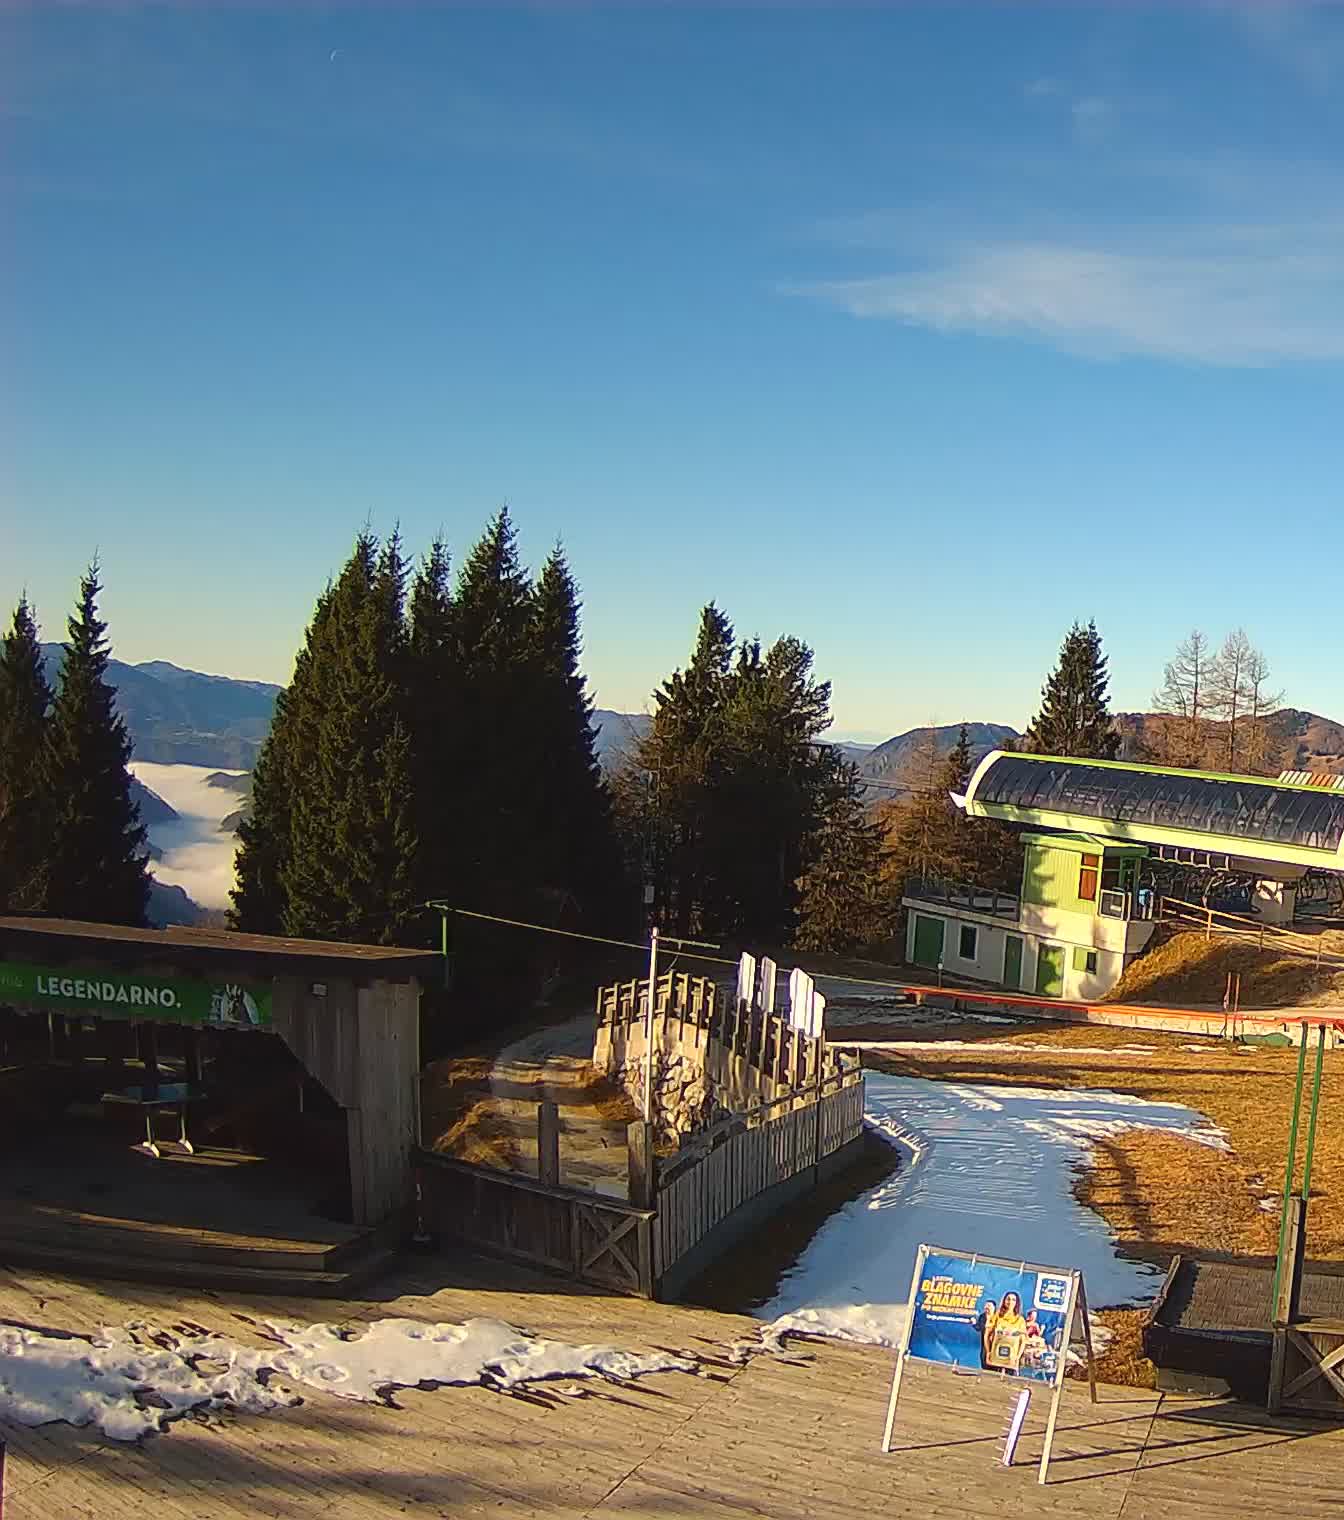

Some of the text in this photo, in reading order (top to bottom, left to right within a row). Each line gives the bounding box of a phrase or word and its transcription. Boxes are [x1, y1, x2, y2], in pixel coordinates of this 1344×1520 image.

[37, 975, 181, 1008] LEGENDARNO.
[920, 1279, 985, 1298] BLAGOVNE
[923, 1292, 977, 1308] ZNAMKE
